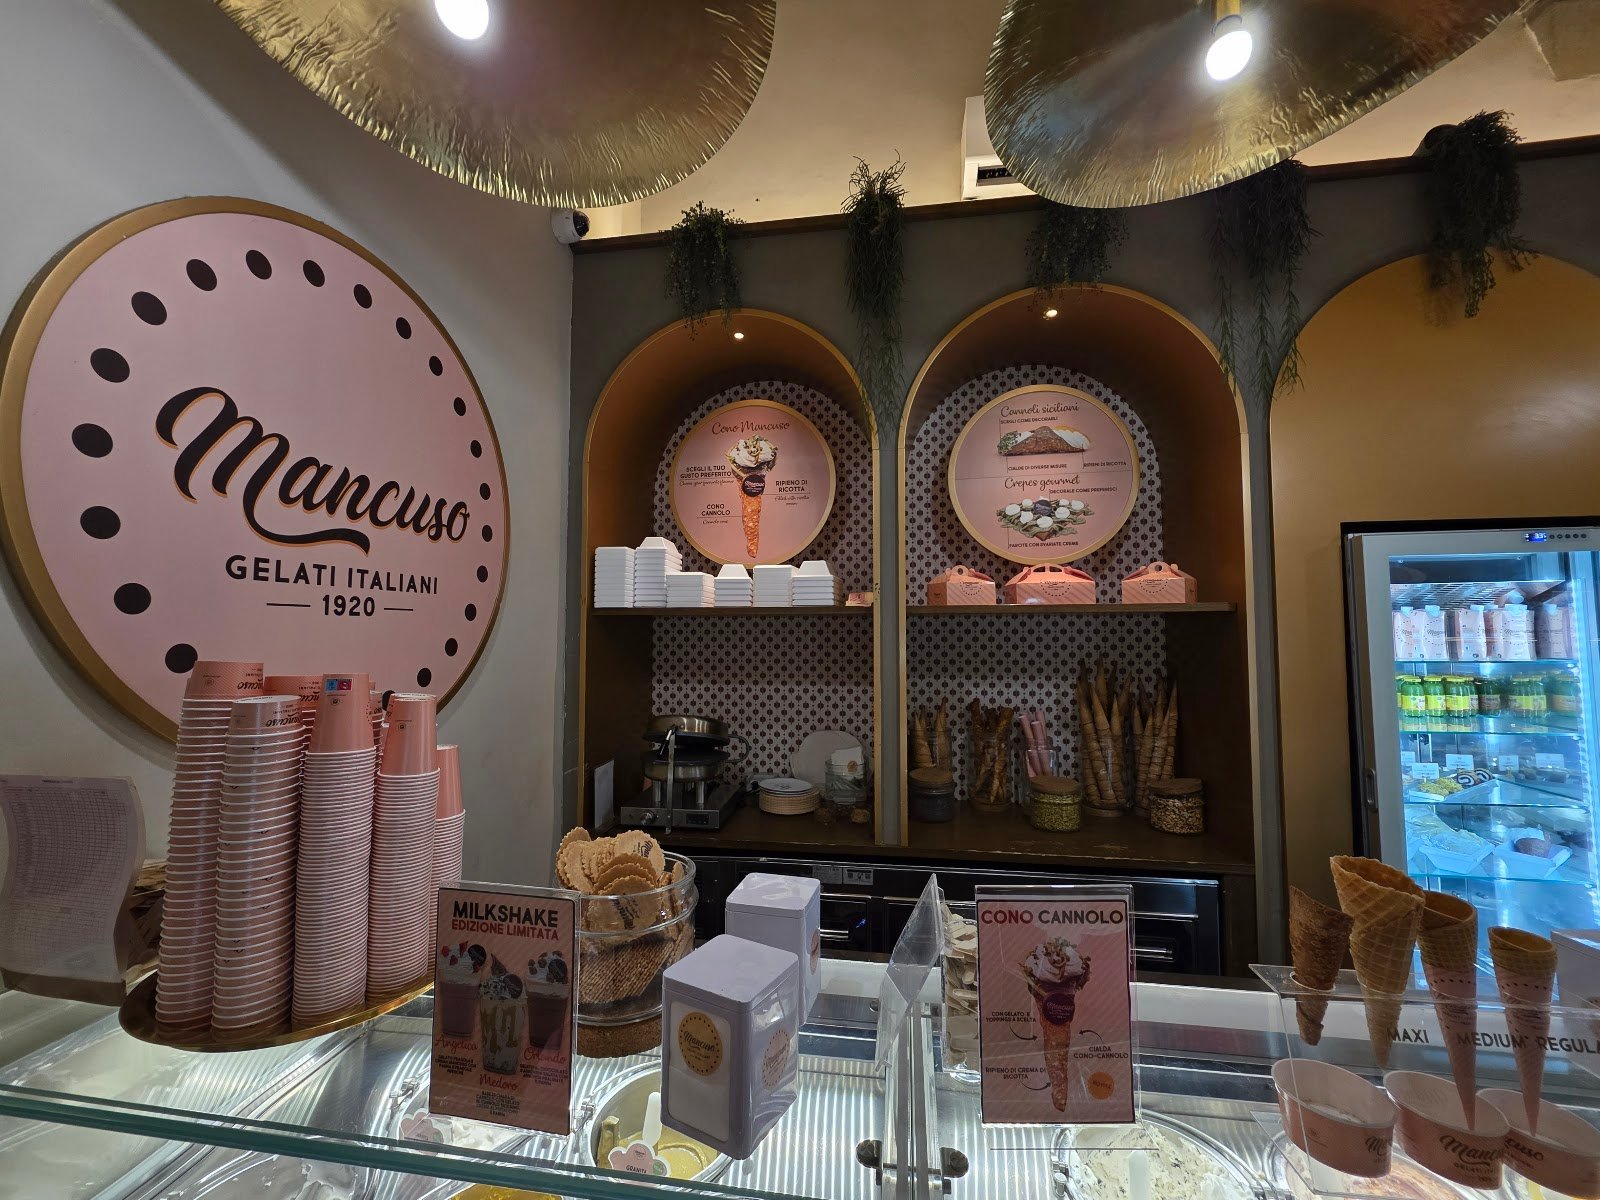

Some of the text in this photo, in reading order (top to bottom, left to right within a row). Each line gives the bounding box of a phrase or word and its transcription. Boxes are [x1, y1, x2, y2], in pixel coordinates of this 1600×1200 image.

[1000, 402, 1079, 418] Cannoli siciliani
[711, 420, 790, 435] Cono Mancuso
[155, 387, 470, 556] Mancuso
[686, 465, 706, 473] SCEGLI
[775, 479, 800, 487] RIPIENO
[1004, 475, 1079, 491] Crepes gourmet
[225, 554, 438, 595] GELATI ITALIANI
[322, 594, 376, 617] 1920
[452, 900, 559, 928] MILKSHAKE
[980, 909, 1124, 925] CONO CANNOLO
[451, 918, 559, 941] EDIZIONE LIMITATA
[625, 1164, 647, 1174] GRANITA
